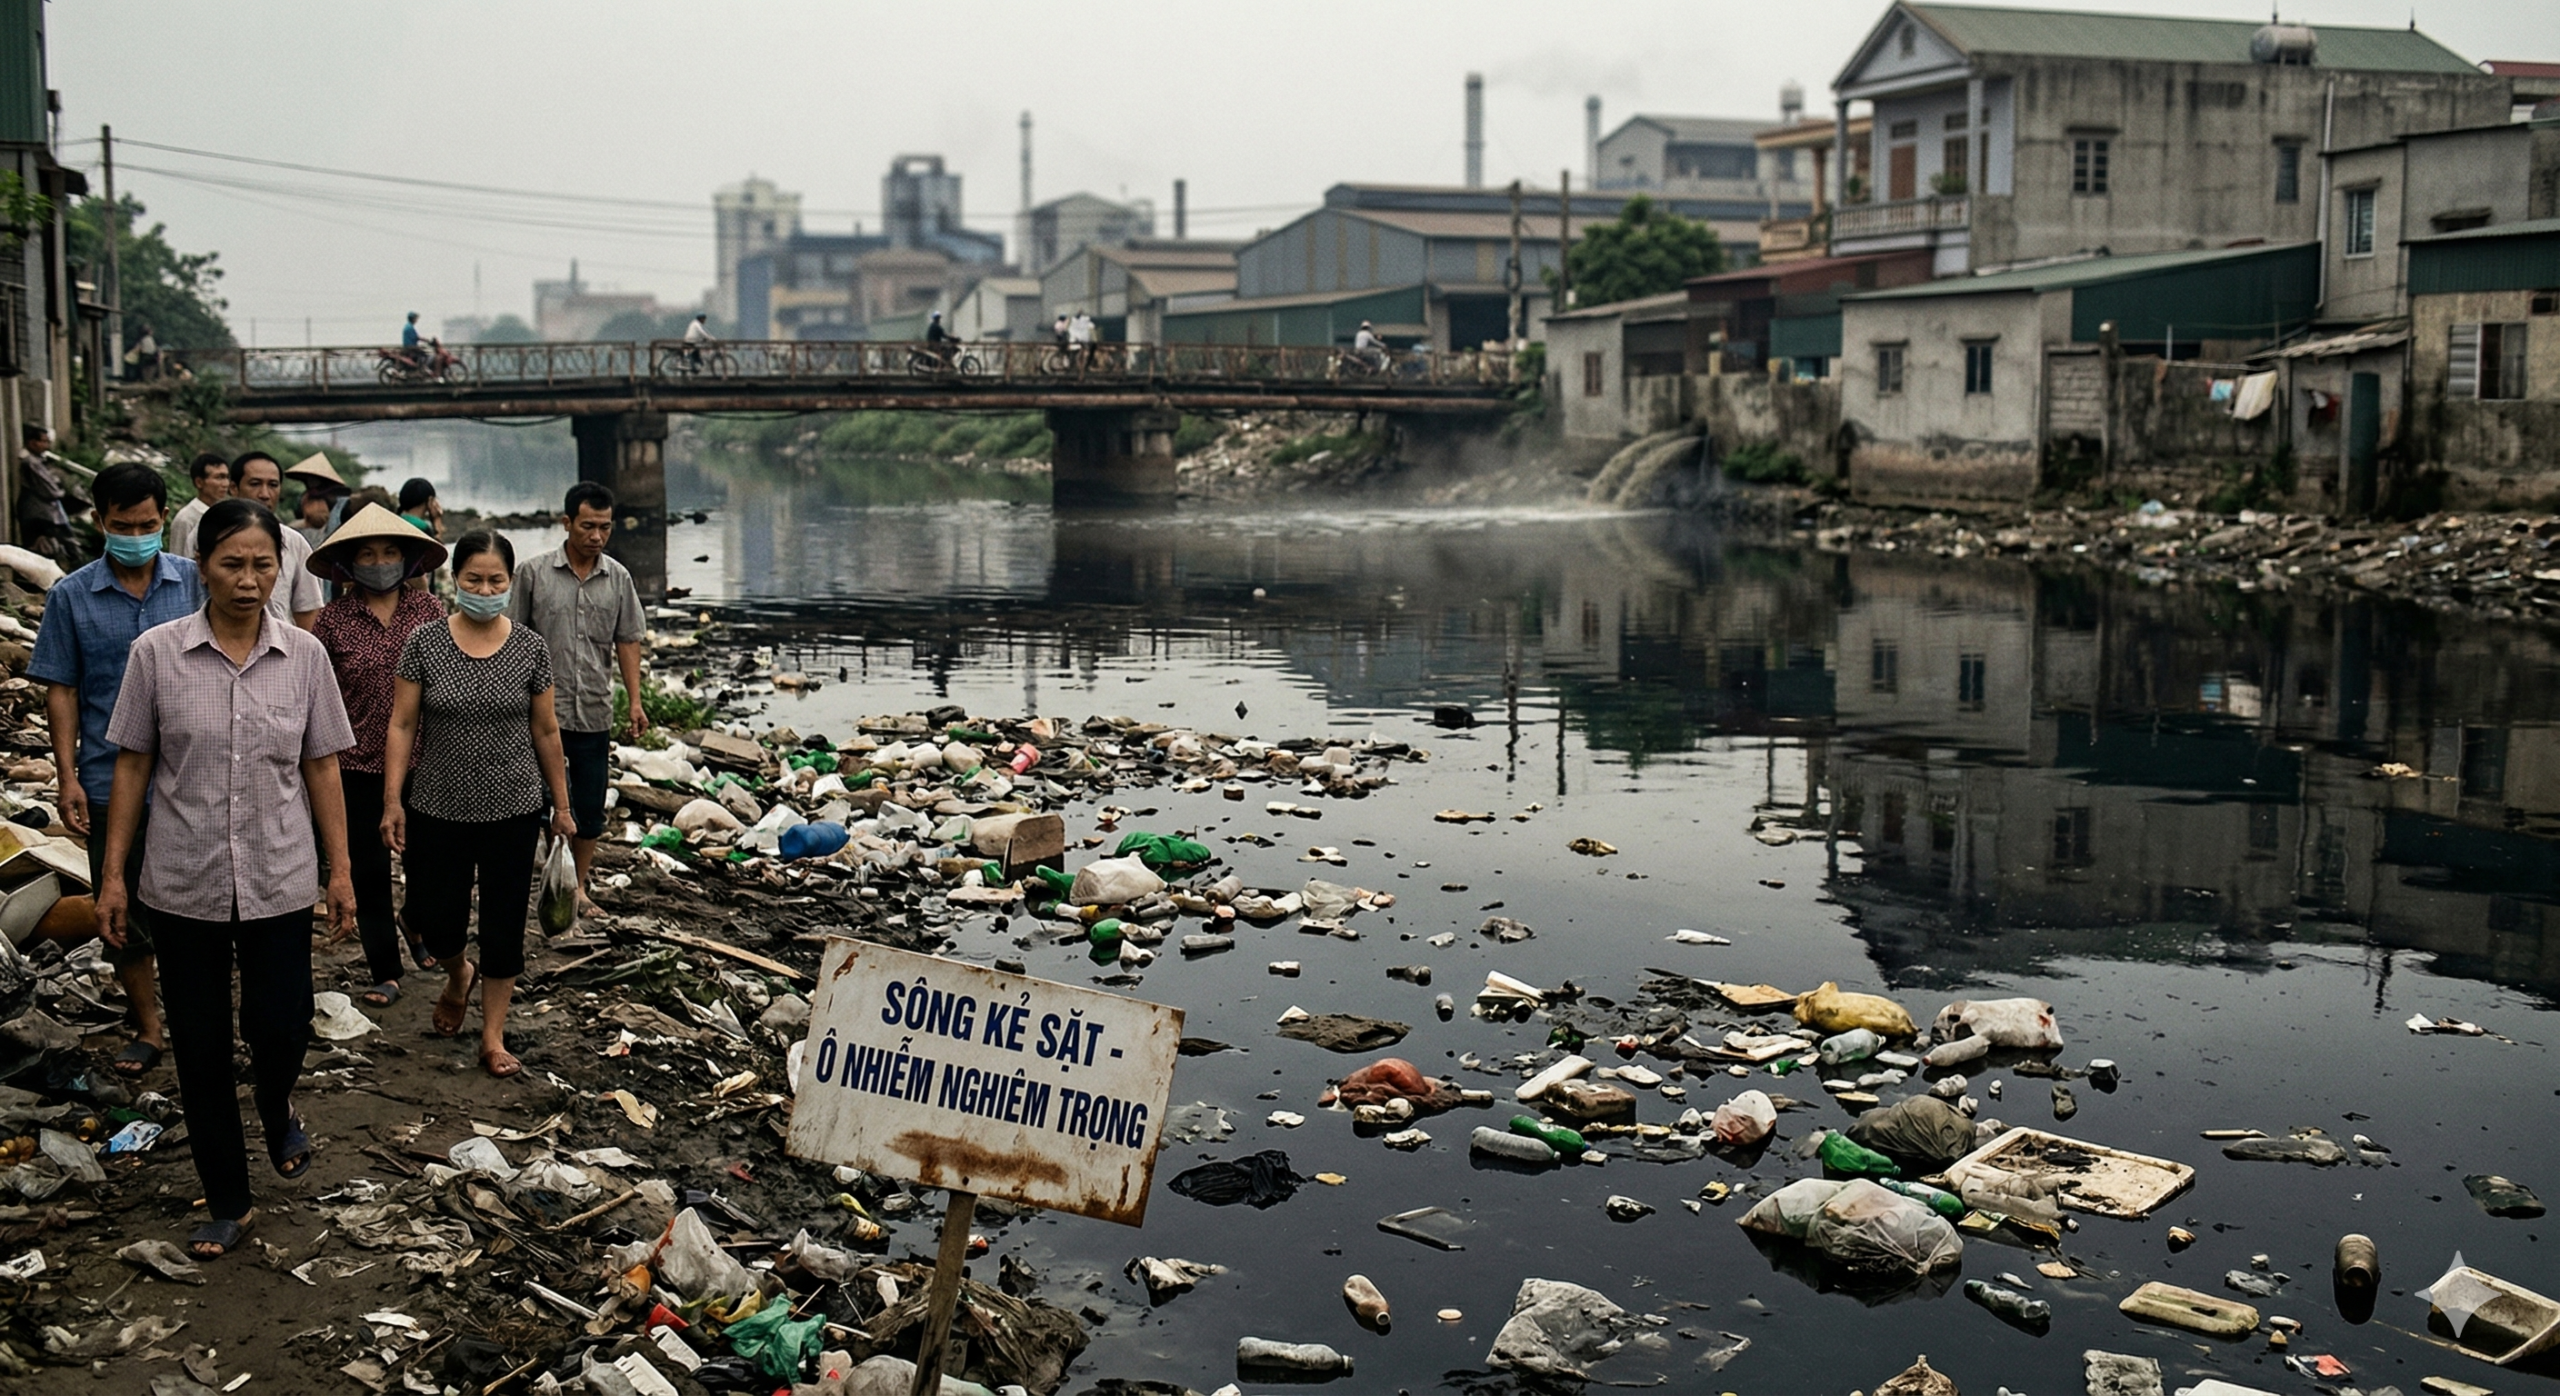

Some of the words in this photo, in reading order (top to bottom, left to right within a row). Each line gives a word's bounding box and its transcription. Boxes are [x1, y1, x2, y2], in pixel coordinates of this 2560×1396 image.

[881, 976, 976, 1041] SÔNG
[983, 992, 1031, 1053] KẺ
[1036, 1008, 1105, 1073] SẶT
[1109, 1047, 1123, 1059] -
[816, 1028, 838, 1083] Ô
[841, 1036, 936, 1104] NHIỄM
[938, 1063, 1051, 1129] NGHIÊM
[1056, 1087, 1149, 1151] TRỌNG
